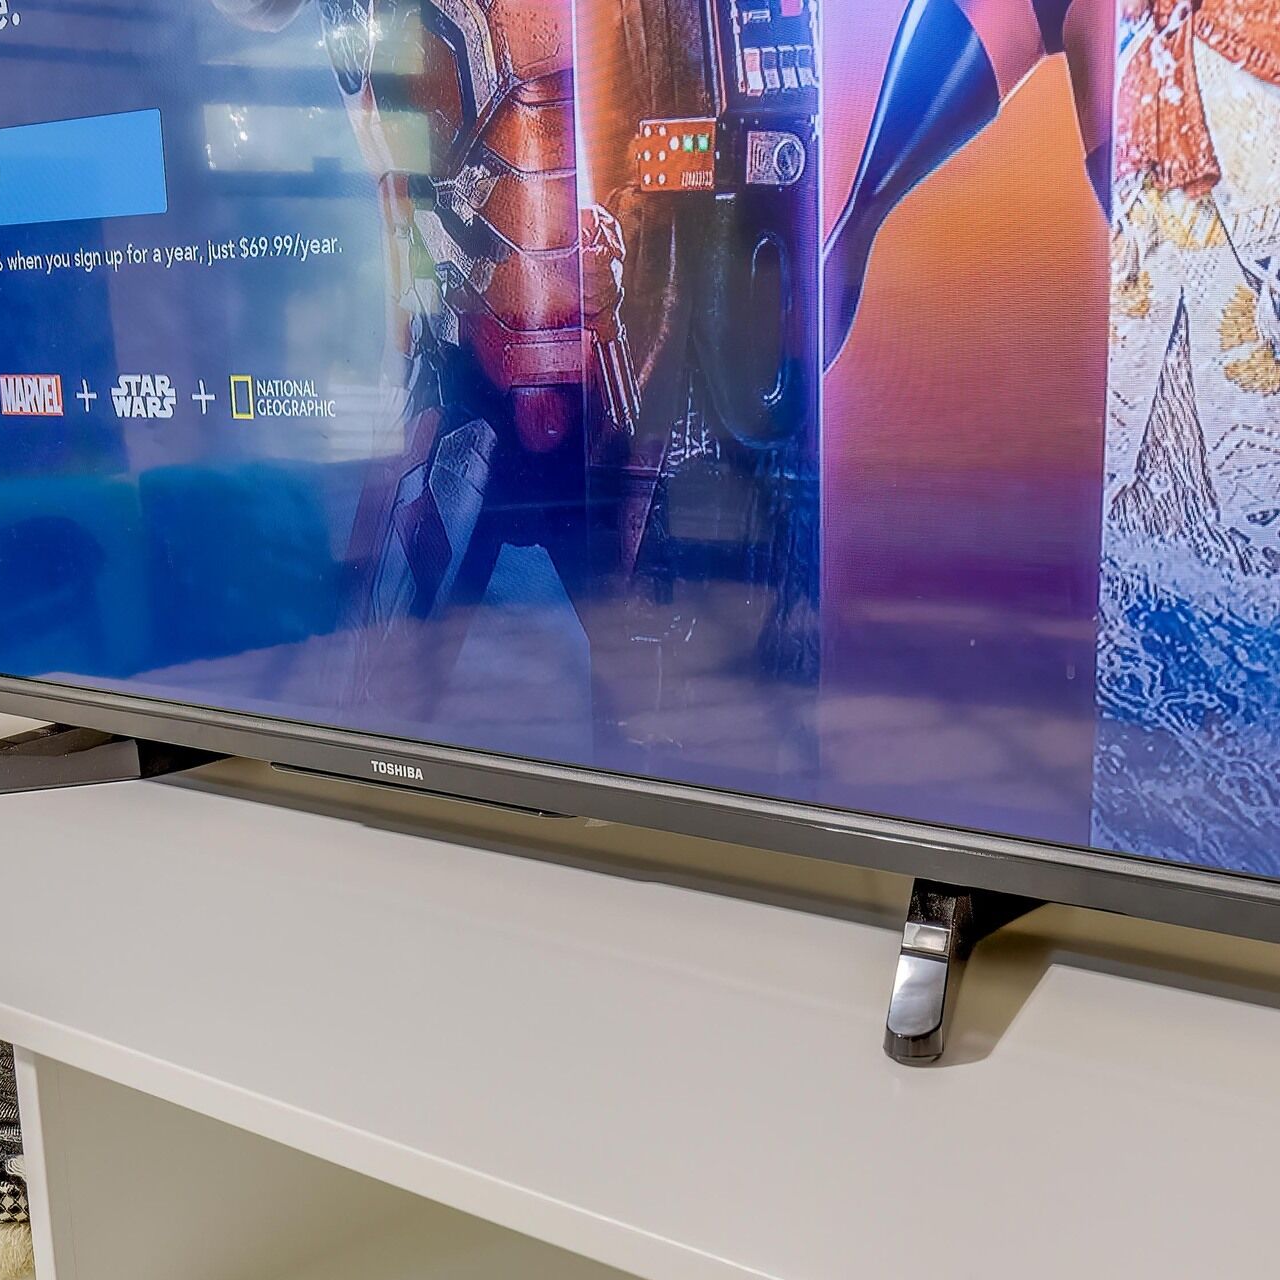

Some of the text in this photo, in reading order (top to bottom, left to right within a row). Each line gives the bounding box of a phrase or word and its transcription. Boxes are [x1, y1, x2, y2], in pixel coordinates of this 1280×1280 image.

[7, 250, 42, 271] when
[45, 255, 70, 275] you
[74, 248, 102, 272] sign
[105, 249, 123, 271] up
[127, 243, 148, 264] for
[152, 248, 162, 263] a
[165, 240, 203, 268] year,
[207, 239, 235, 266] just
[239, 233, 342, 262] $69.99/year.
[0, 375, 63, 415] MARVEL
[111, 374, 176, 396] STAR
[257, 379, 318, 398] NATIONAL
[111, 396, 176, 418] WARS
[257, 399, 336, 417] GEOGRAPHIC
[371, 760, 424, 780] TOSHIBA
